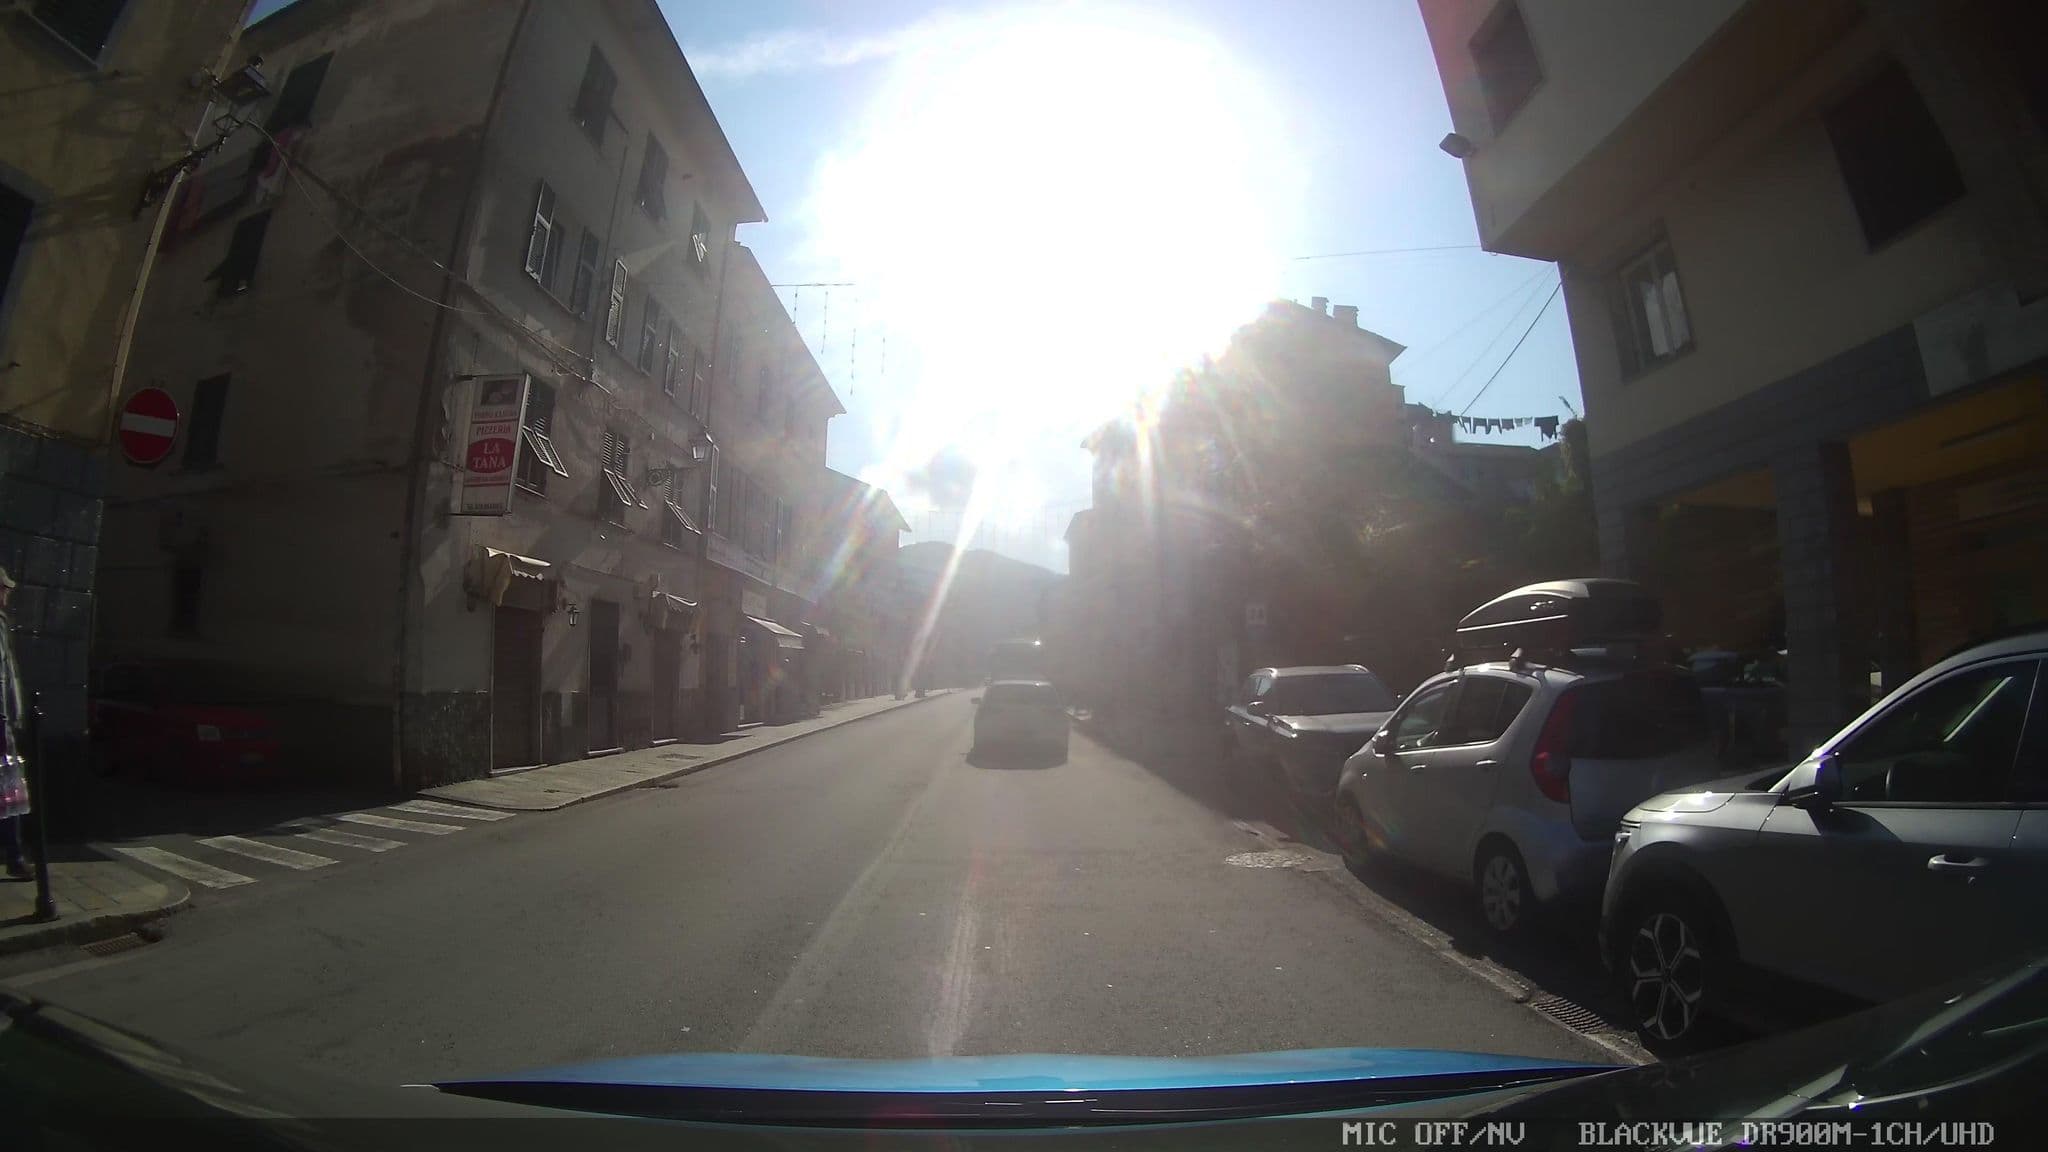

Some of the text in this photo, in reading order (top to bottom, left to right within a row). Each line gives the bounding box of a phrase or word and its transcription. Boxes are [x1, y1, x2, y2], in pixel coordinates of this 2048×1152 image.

[476, 424, 511, 435] PIZZERIA
[483, 442, 500, 454] LA
[472, 456, 507, 469] TANA
